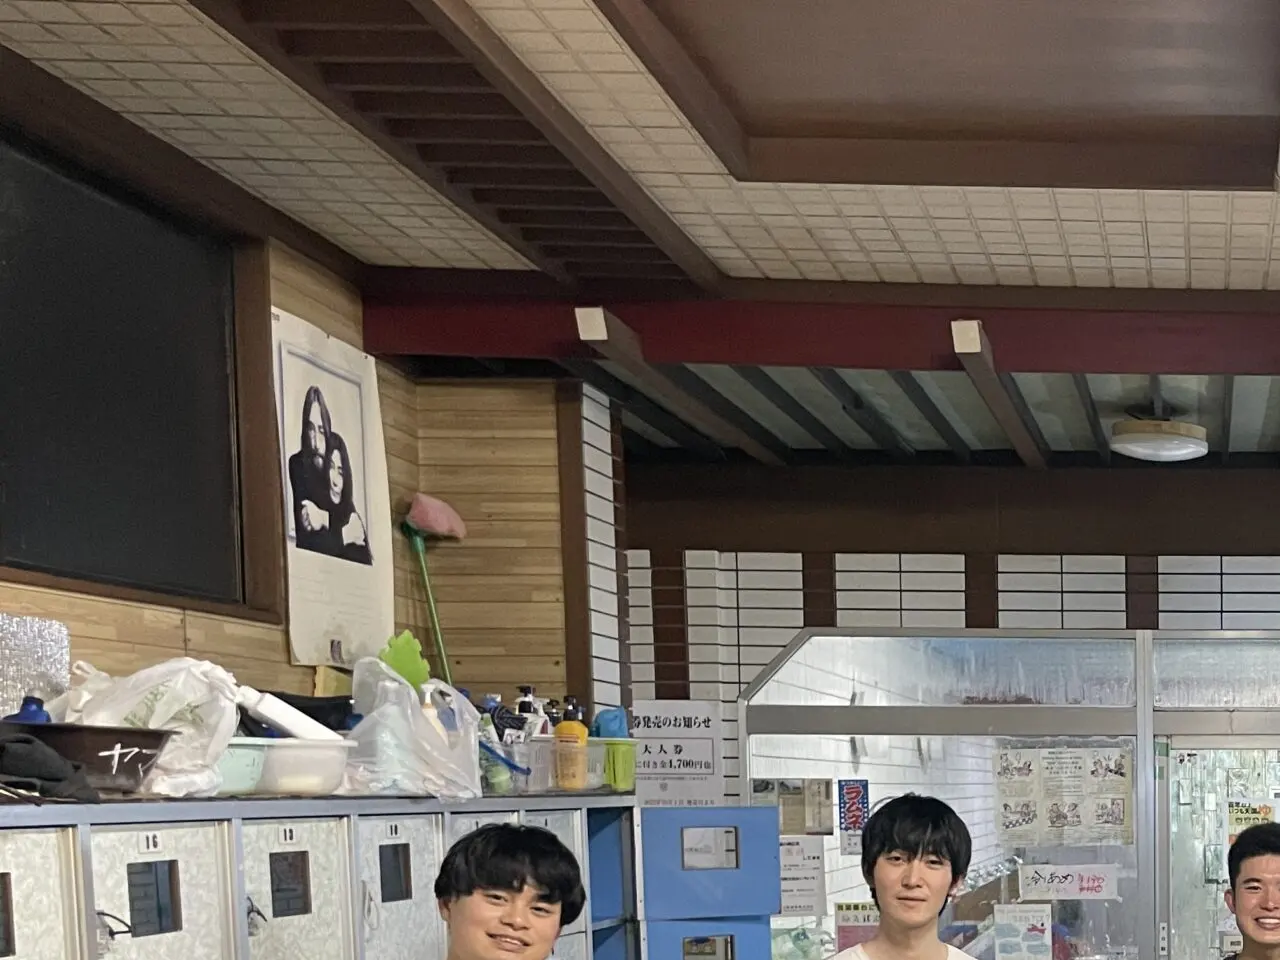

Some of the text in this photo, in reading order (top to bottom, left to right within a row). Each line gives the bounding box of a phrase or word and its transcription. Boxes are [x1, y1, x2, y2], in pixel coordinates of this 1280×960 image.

[842, 784, 865, 831] ラムネ
[145, 833, 158, 850] 16
